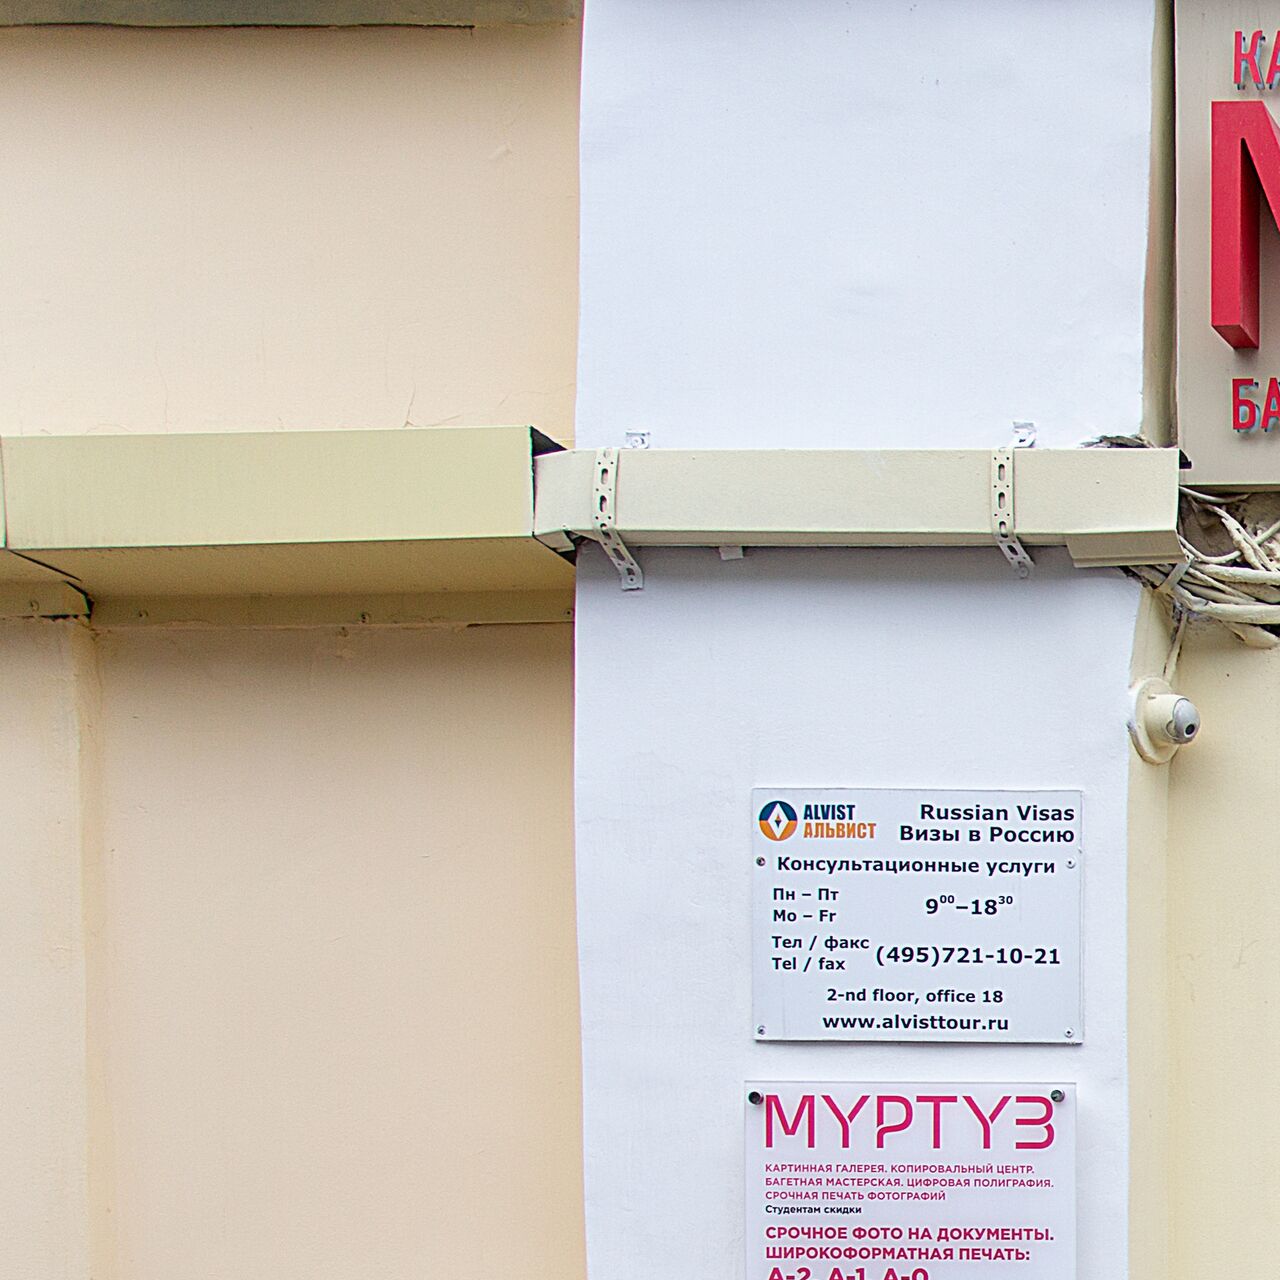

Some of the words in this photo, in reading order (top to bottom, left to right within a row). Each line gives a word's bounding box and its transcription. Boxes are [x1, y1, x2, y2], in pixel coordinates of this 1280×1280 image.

[804, 804, 856, 820] ALVIST
[920, 804, 1008, 820] Russian
[1017, 805, 1075, 820] Visas
[804, 822, 877, 839] АЛЬВИСТ
[900, 826, 959, 841] Визы
[969, 830, 981, 841] в
[990, 827, 1075, 842] Россию
[777, 857, 980, 874] Консультационные
[986, 862, 1055, 876] услуги
[773, 888, 795, 900] Пн
[818, 888, 839, 900] Пт
[773, 910, 797, 922] Mo
[819, 910, 837, 922] Fr
[772, 936, 802, 949] Тел
[824, 936, 869, 951] факс
[876, 946, 1061, 967] (495)721-10-21
[772, 958, 797, 970] Tel
[818, 958, 845, 970] fax
[827, 989, 866, 1002] 2-nd
[873, 990, 919, 1004] floor,
[926, 990, 976, 1003] office
[982, 991, 1003, 1003] 18
[823, 1016, 1009, 1030] www.alvisttour.ru
[765, 1164, 832, 1172] КАРТИННАЯ
[836, 1164, 888, 1173] ГАЛЕРЕЯ.
[891, 1163, 993, 1173] КОПИРОВАЛЬНЫЙ
[996, 1165, 1035, 1175] ЦЕНТР.
[765, 1178, 823, 1186] БАГЕТНАЯ
[826, 1178, 903, 1186] МАСТЕРСКАЯ.
[907, 1178, 970, 1188] ЦИФРОВАЯ
[974, 1178, 1054, 1188] ПОЛИГРАФИЯ.
[765, 1191, 818, 1199] СРОЧНАЯ
[822, 1191, 864, 1200] ПЕЧАТЬ
[867, 1190, 946, 1200] ФОТОГРАФИЙ
[765, 1205, 821, 1215] Студентам
[824, 1206, 862, 1215] скидки
[766, 1227, 847, 1239] СРОЧНОЕ
[852, 1227, 903, 1240] ФОТО
[908, 1228, 932, 1240] НА
[937, 1228, 1054, 1242] ДОКУМЕНТЫ.
[766, 1247, 953, 1260] ШИРОКОФОРМАТНАЯ
[959, 1249, 1030, 1261] ПЕЧАТЬ:
